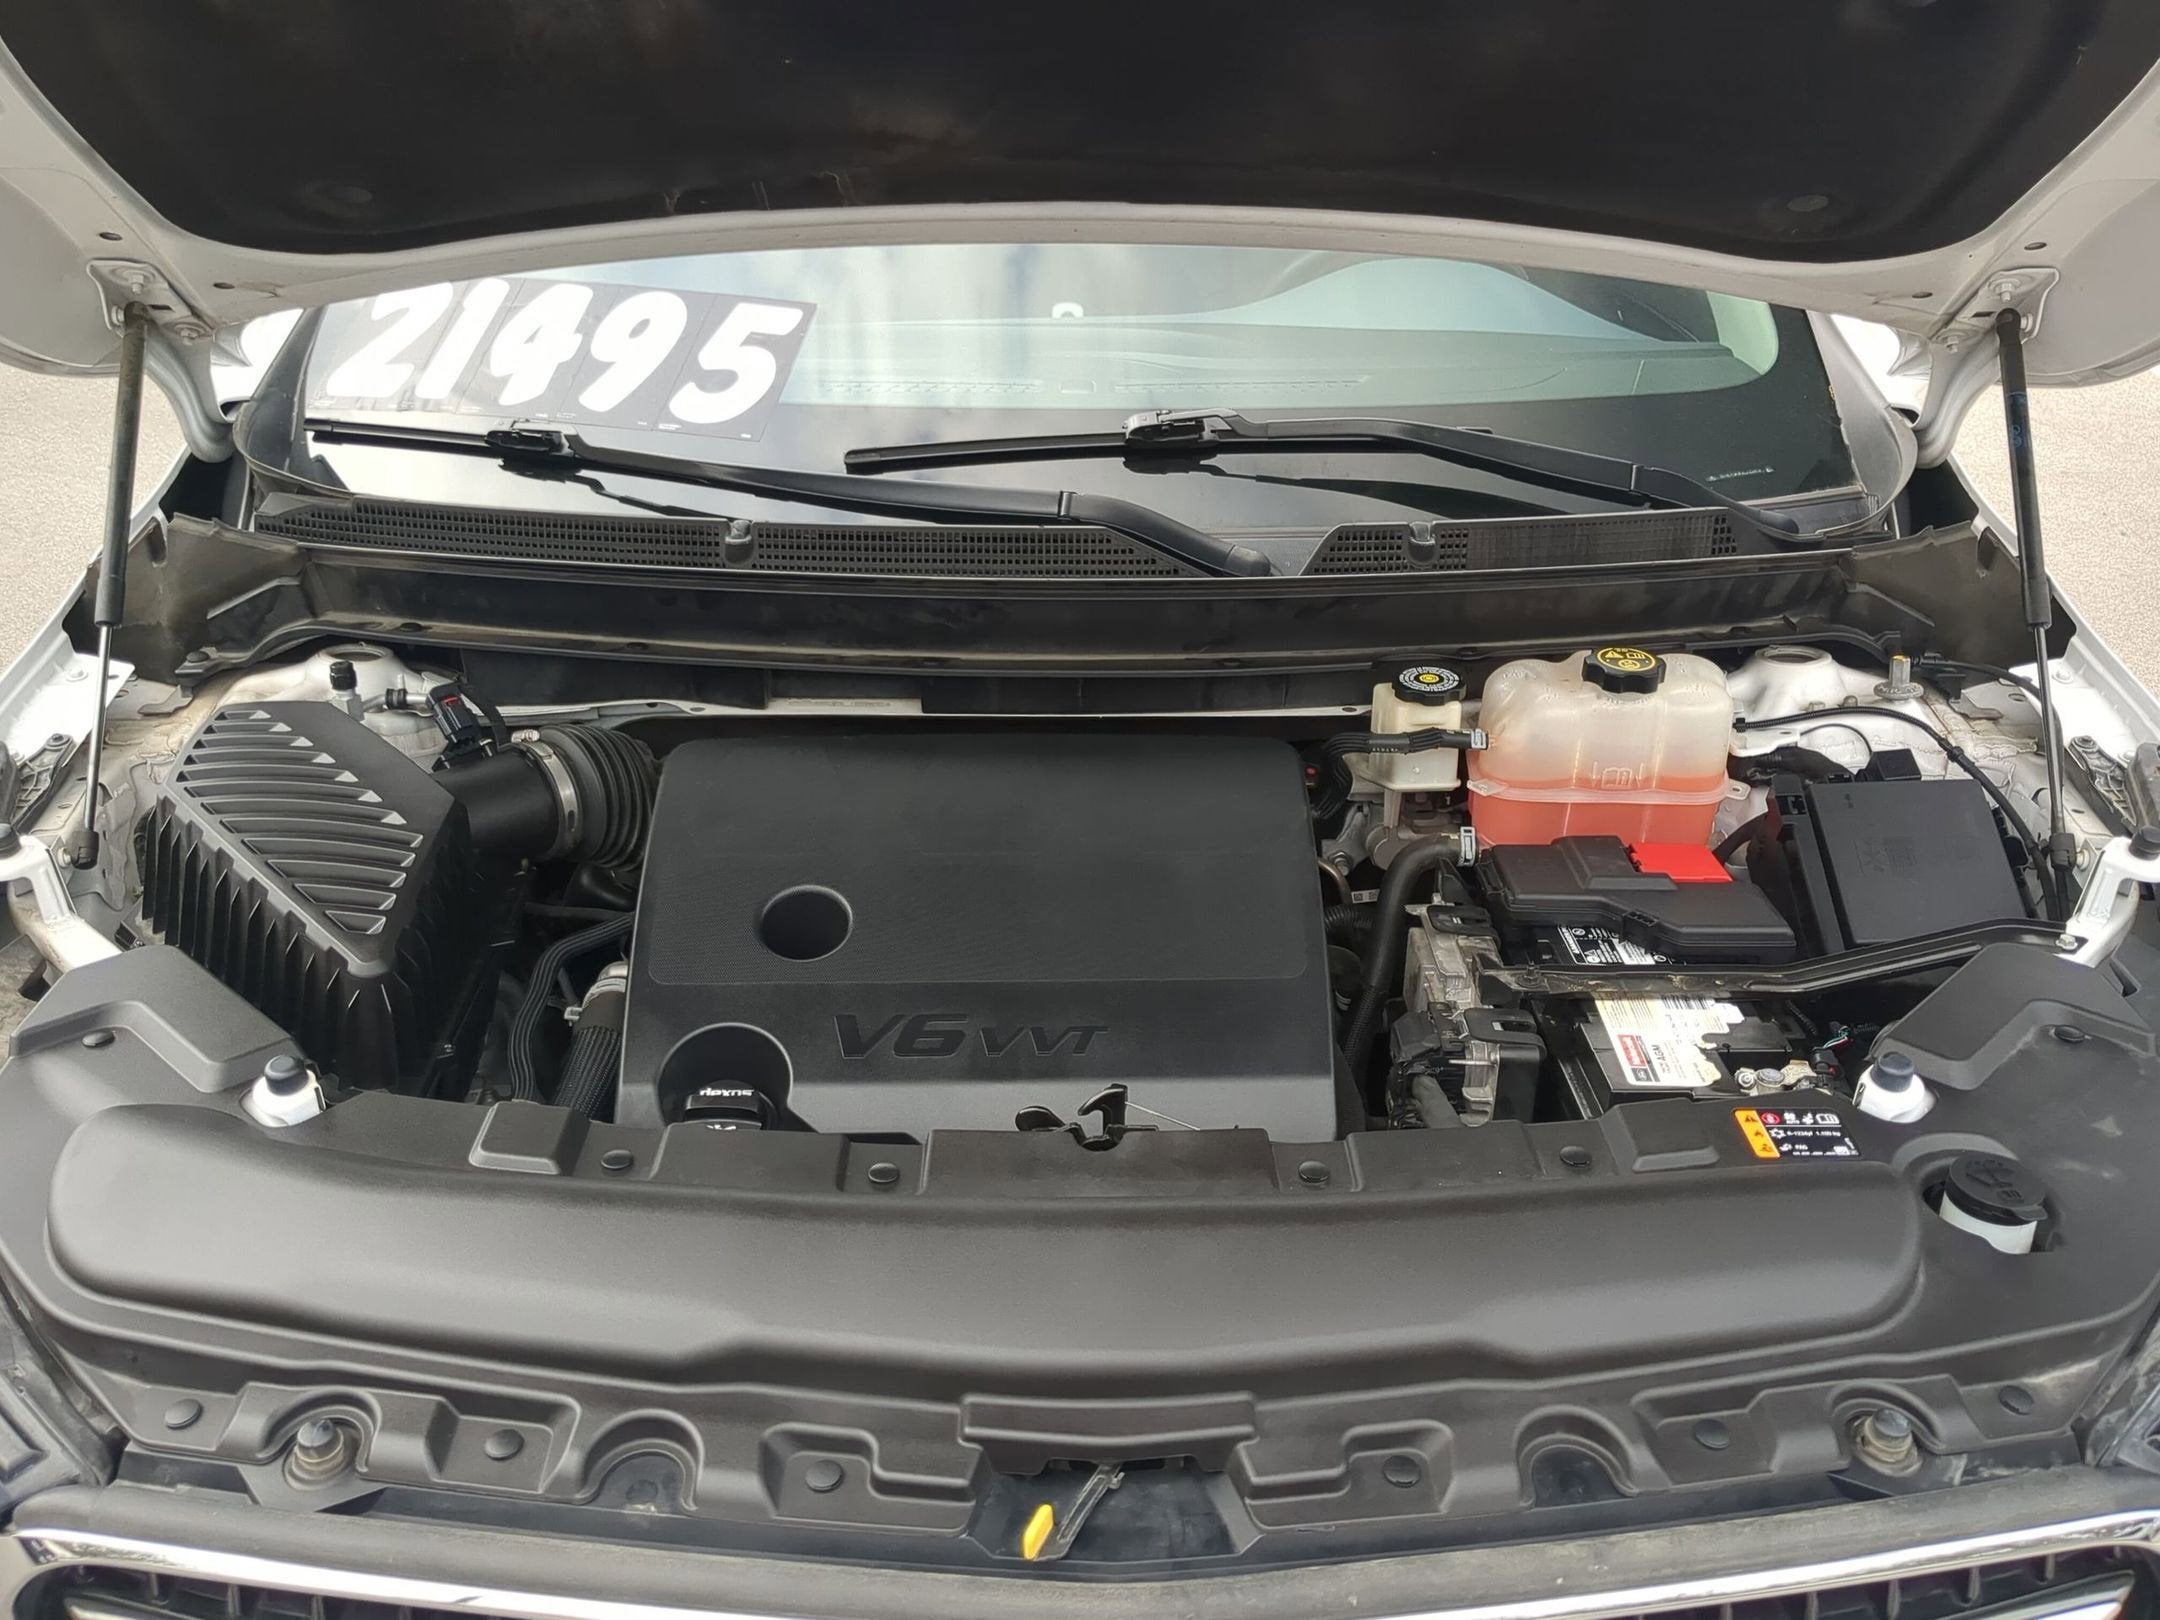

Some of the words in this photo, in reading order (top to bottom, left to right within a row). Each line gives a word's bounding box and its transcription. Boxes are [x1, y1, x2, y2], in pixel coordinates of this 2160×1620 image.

[326, 277, 804, 424] 21495
[834, 1013, 968, 1059] V6
[979, 1025, 1109, 1057] VVT
[699, 1087, 755, 1097] dexos
